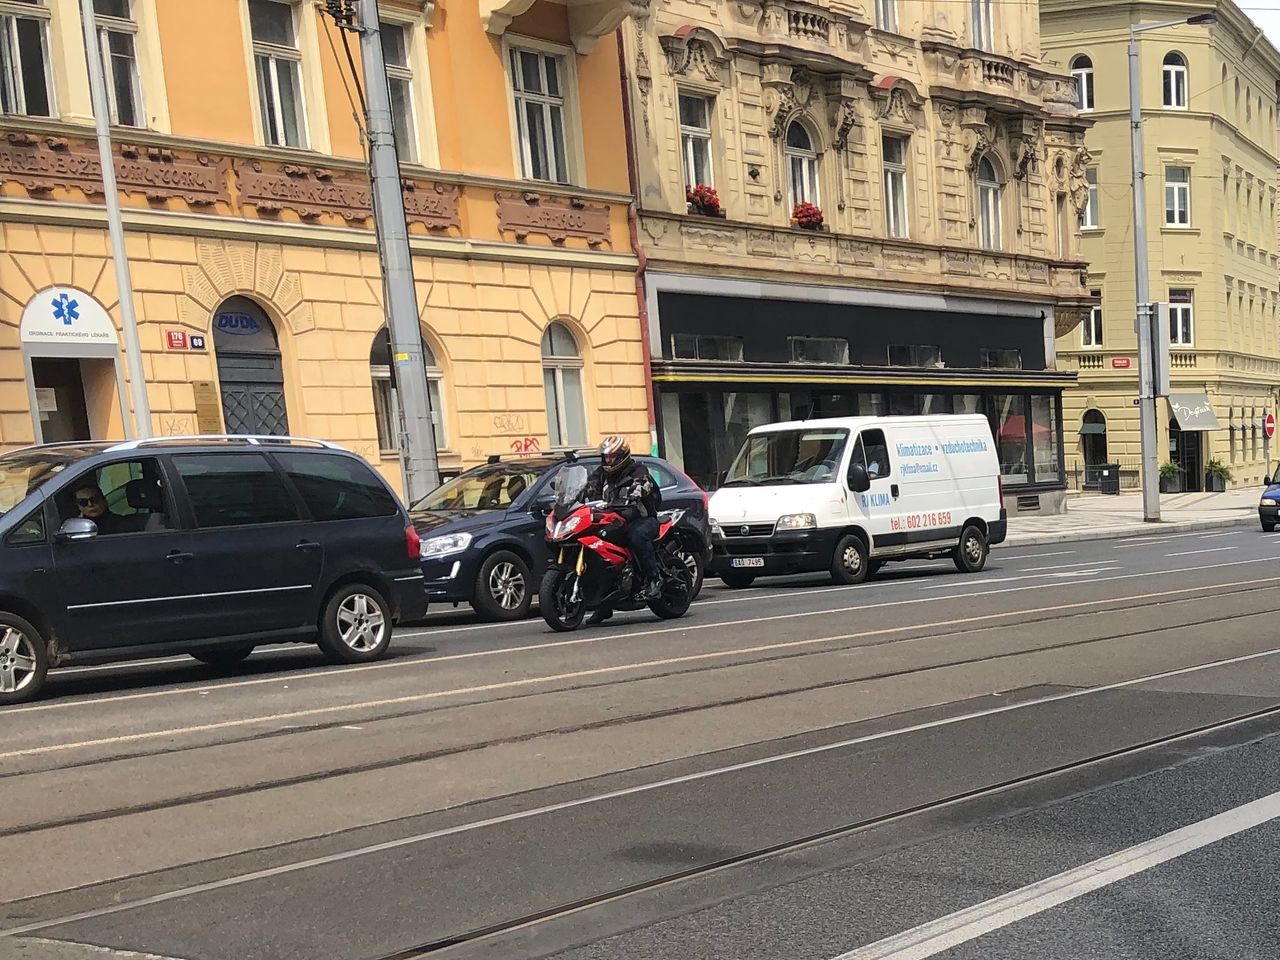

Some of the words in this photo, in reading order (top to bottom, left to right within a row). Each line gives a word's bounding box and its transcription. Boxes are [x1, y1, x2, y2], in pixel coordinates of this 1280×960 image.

[896, 443, 932, 457] klimatizace
[941, 439, 987, 454] vzduchotechnika
[861, 494, 869, 507] RJ
[870, 493, 890, 507] KLIMA
[891, 517, 906, 530] tel.:
[907, 515, 921, 529] 602
[923, 513, 937, 527] 216
[938, 512, 952, 525] 659
